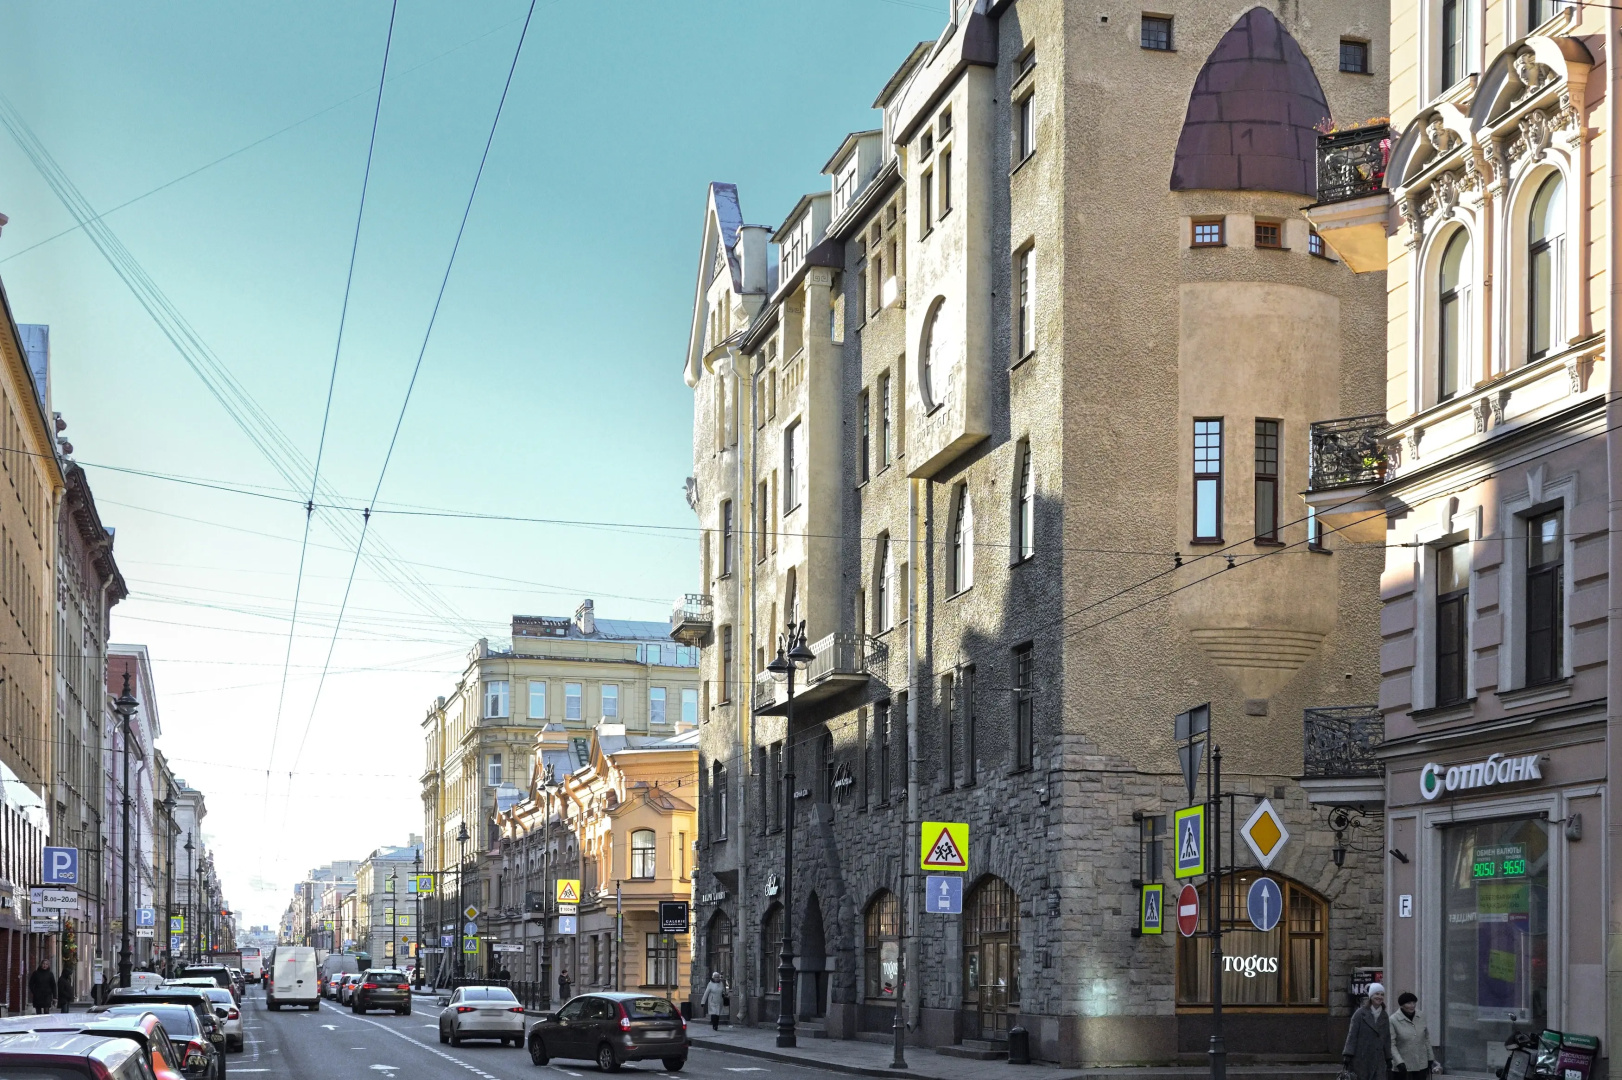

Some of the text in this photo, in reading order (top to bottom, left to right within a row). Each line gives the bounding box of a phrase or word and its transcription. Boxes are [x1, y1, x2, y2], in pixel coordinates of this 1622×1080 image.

[1476, 846, 1522, 856] ОБМЕН ВАЛЮТЫ
[52, 851, 72, 880] P
[141, 911, 151, 924] P
[1222, 954, 1278, 978] Togas
